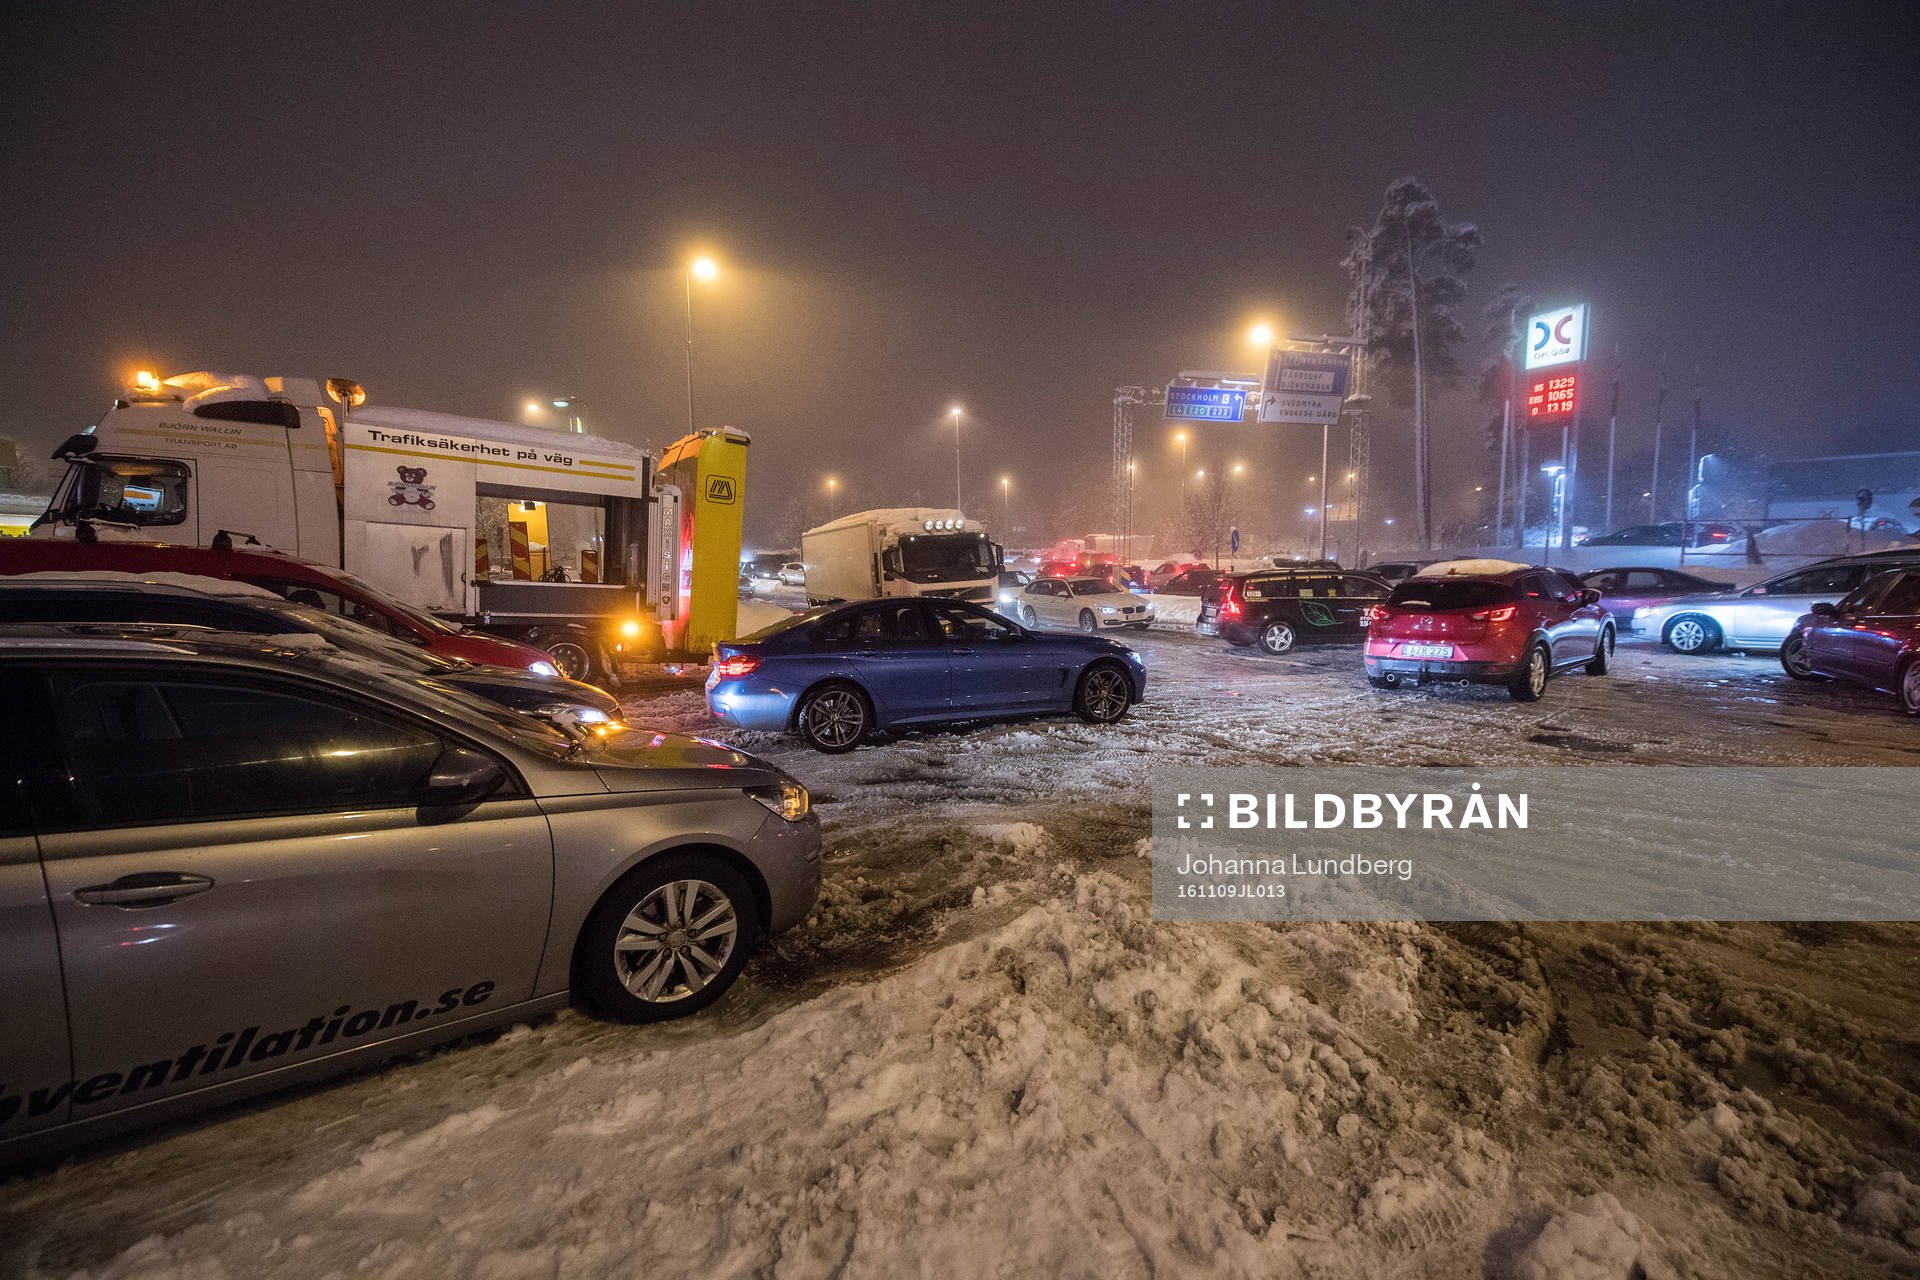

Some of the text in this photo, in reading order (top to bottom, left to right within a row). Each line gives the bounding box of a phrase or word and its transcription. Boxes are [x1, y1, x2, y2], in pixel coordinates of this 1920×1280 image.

[1549, 377, 1575, 390] 1329
[1170, 392, 1219, 402] STOCKHOLM
[1548, 388, 1574, 402] 1065
[1547, 400, 1573, 414] 1319
[201, 425, 242, 434] WALLIN
[165, 438, 221, 448] TRANSPORT
[368, 430, 573, 466] Trafiksäkerhet på väg
